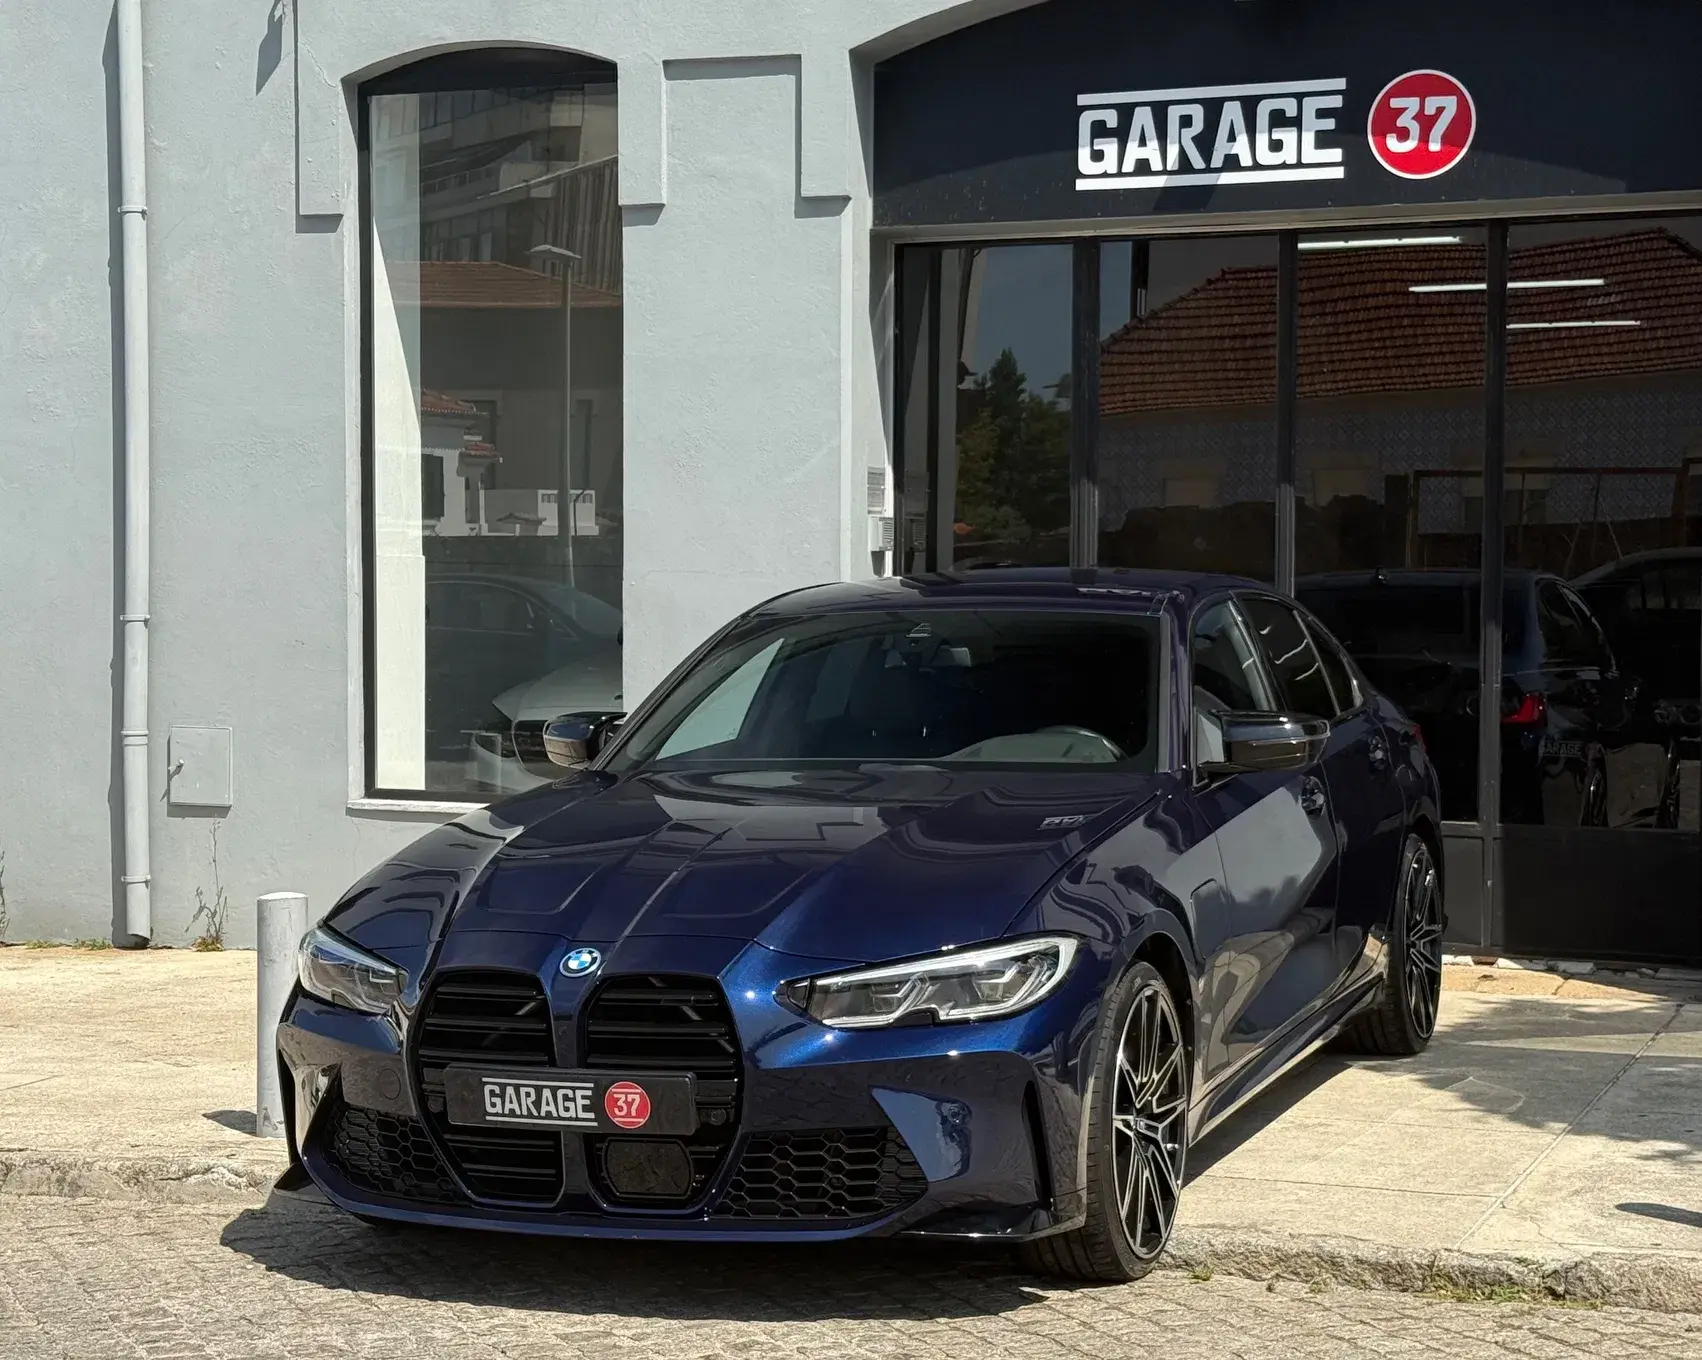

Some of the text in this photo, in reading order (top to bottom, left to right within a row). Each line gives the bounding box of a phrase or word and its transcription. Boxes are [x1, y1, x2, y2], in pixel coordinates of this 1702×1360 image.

[1077, 94, 1458, 176] GARAGE 37
[484, 1084, 640, 1119] GARAGE 37
